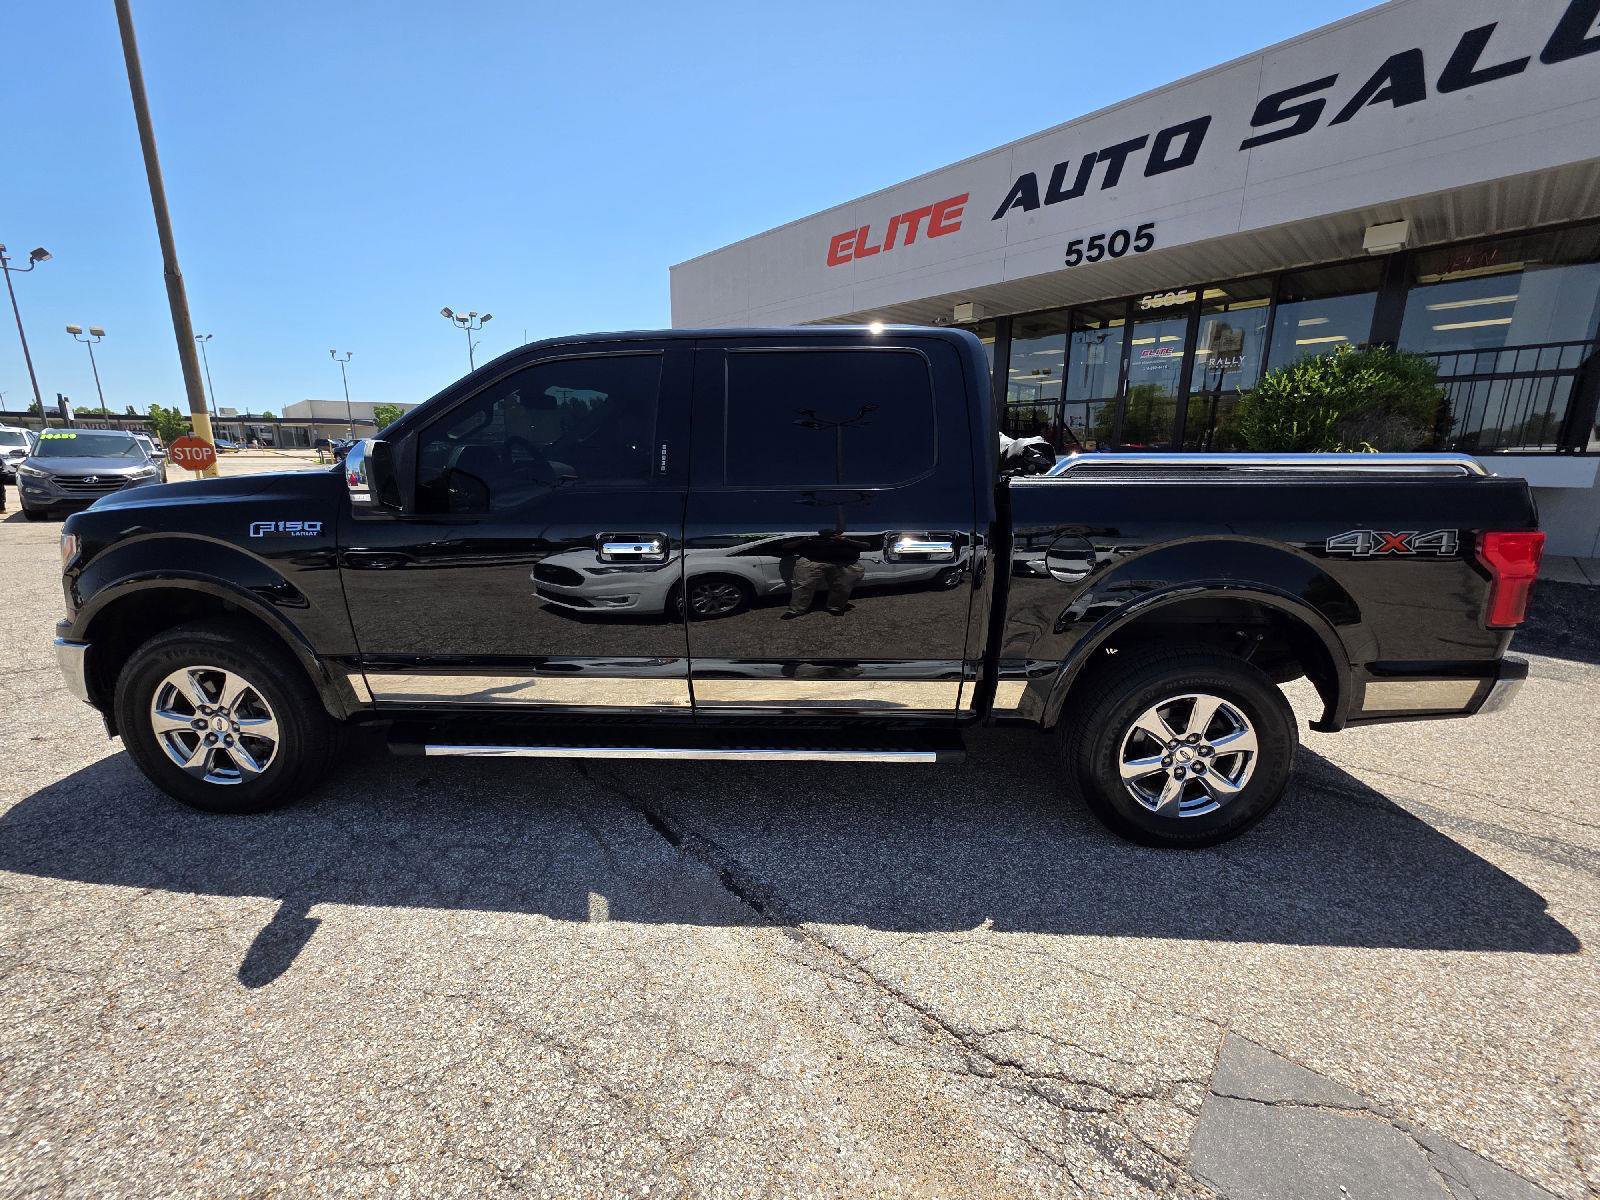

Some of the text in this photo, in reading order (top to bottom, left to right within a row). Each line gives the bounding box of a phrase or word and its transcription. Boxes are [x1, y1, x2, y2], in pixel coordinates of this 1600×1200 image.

[827, 193, 970, 267] ELITE
[991, 115, 1211, 221] AUTO
[1065, 222, 1155, 267] 5505
[1140, 289, 1188, 310] 5505
[1209, 355, 1247, 366] RALLY
[174, 447, 212, 460] STOP
[1326, 529, 1459, 556] 4X4
